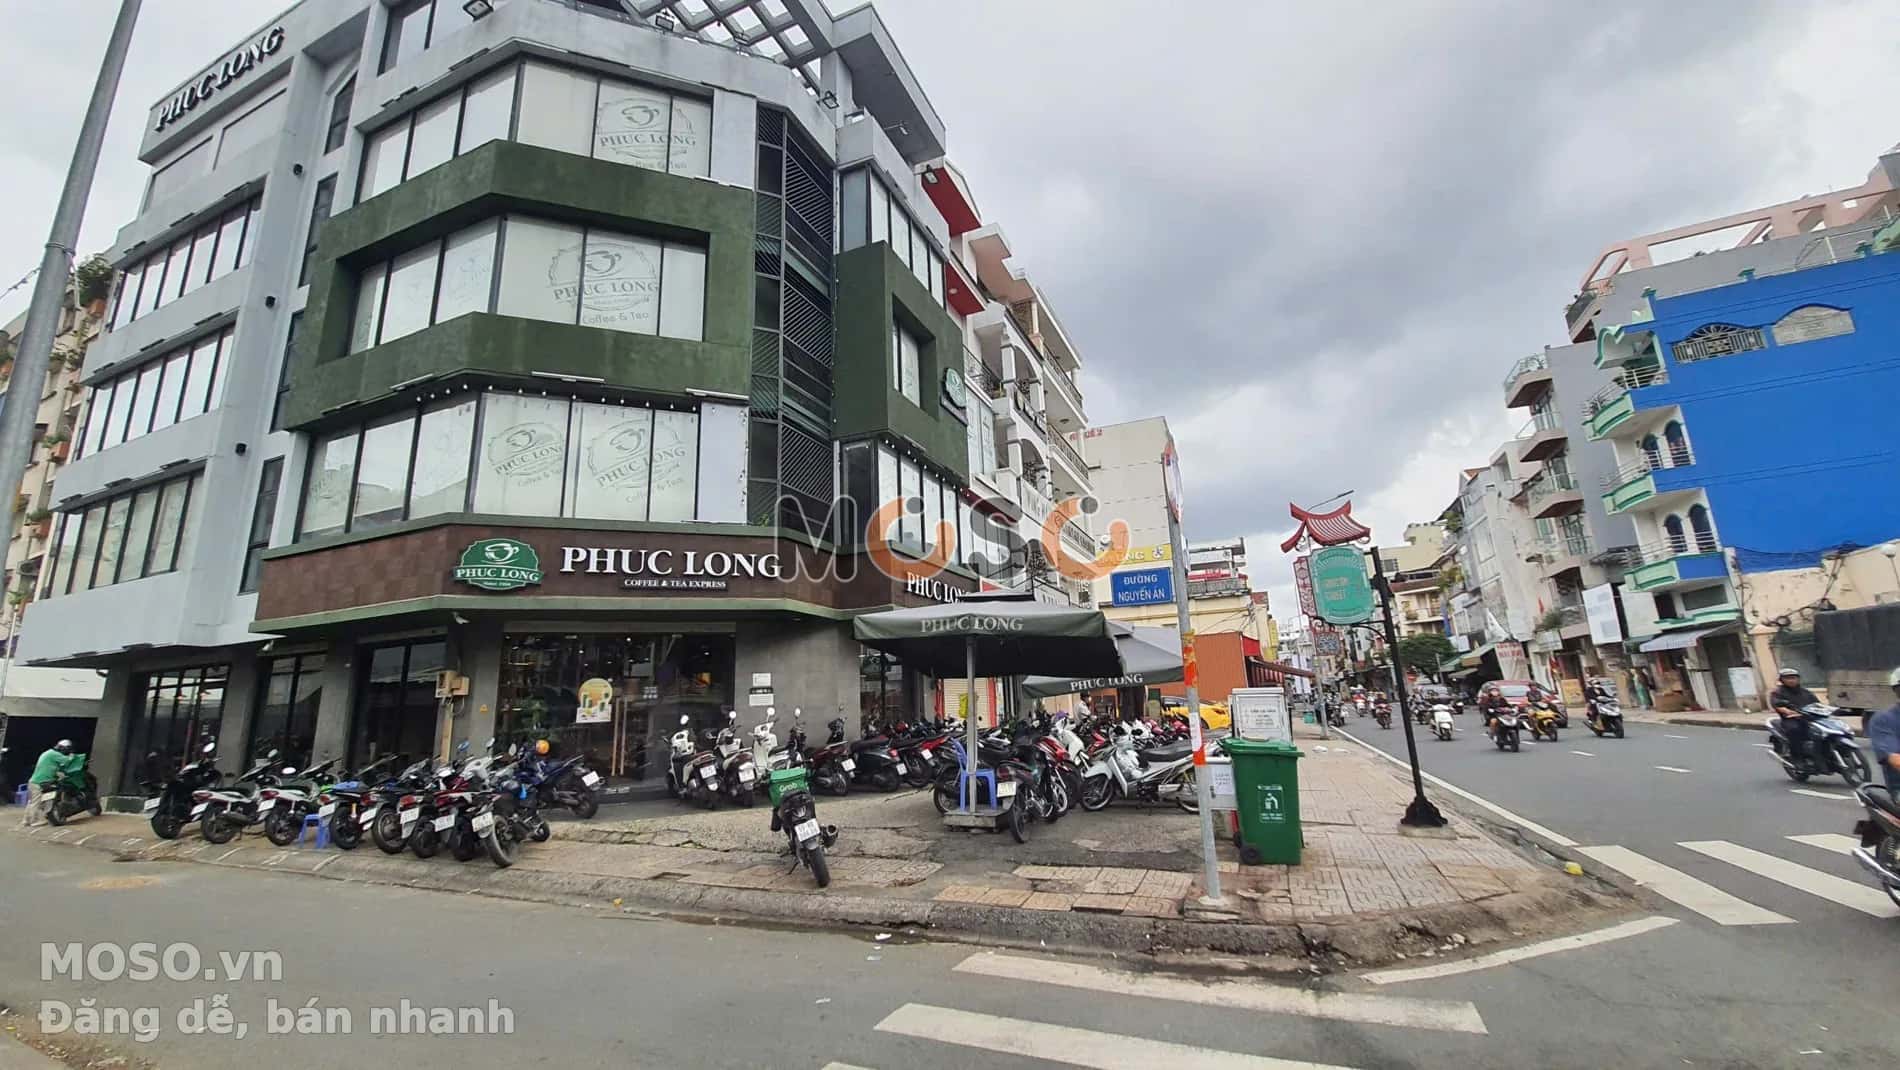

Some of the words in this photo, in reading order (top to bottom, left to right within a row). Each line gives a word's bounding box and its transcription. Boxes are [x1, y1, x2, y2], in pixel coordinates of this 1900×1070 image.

[154, 72, 217, 132] PHUC
[215, 26, 285, 90] LONG
[600, 133, 643, 147] PHUC
[553, 281, 606, 300] PHUC
[611, 280, 660, 293] LONG
[495, 454, 531, 475] PHUC
[595, 460, 642, 487] PHUC
[560, 546, 673, 575] PHUC
[683, 551, 781, 578] LONG
[456, 568, 497, 578] PHUC
[501, 569, 539, 581] LONG
[624, 579, 660, 588] COFFEE
[661, 579, 669, 587] &
[671, 580, 687, 588] TEA
[688, 580, 727, 589] EXPRESS
[906, 571, 942, 601] PHUC
[920, 616, 970, 633] PHUC
[973, 616, 1024, 631] LONG
[1070, 677, 1106, 692] PHUC
[1108, 673, 1144, 686] LONG
[779, 782, 798, 792] Grab
